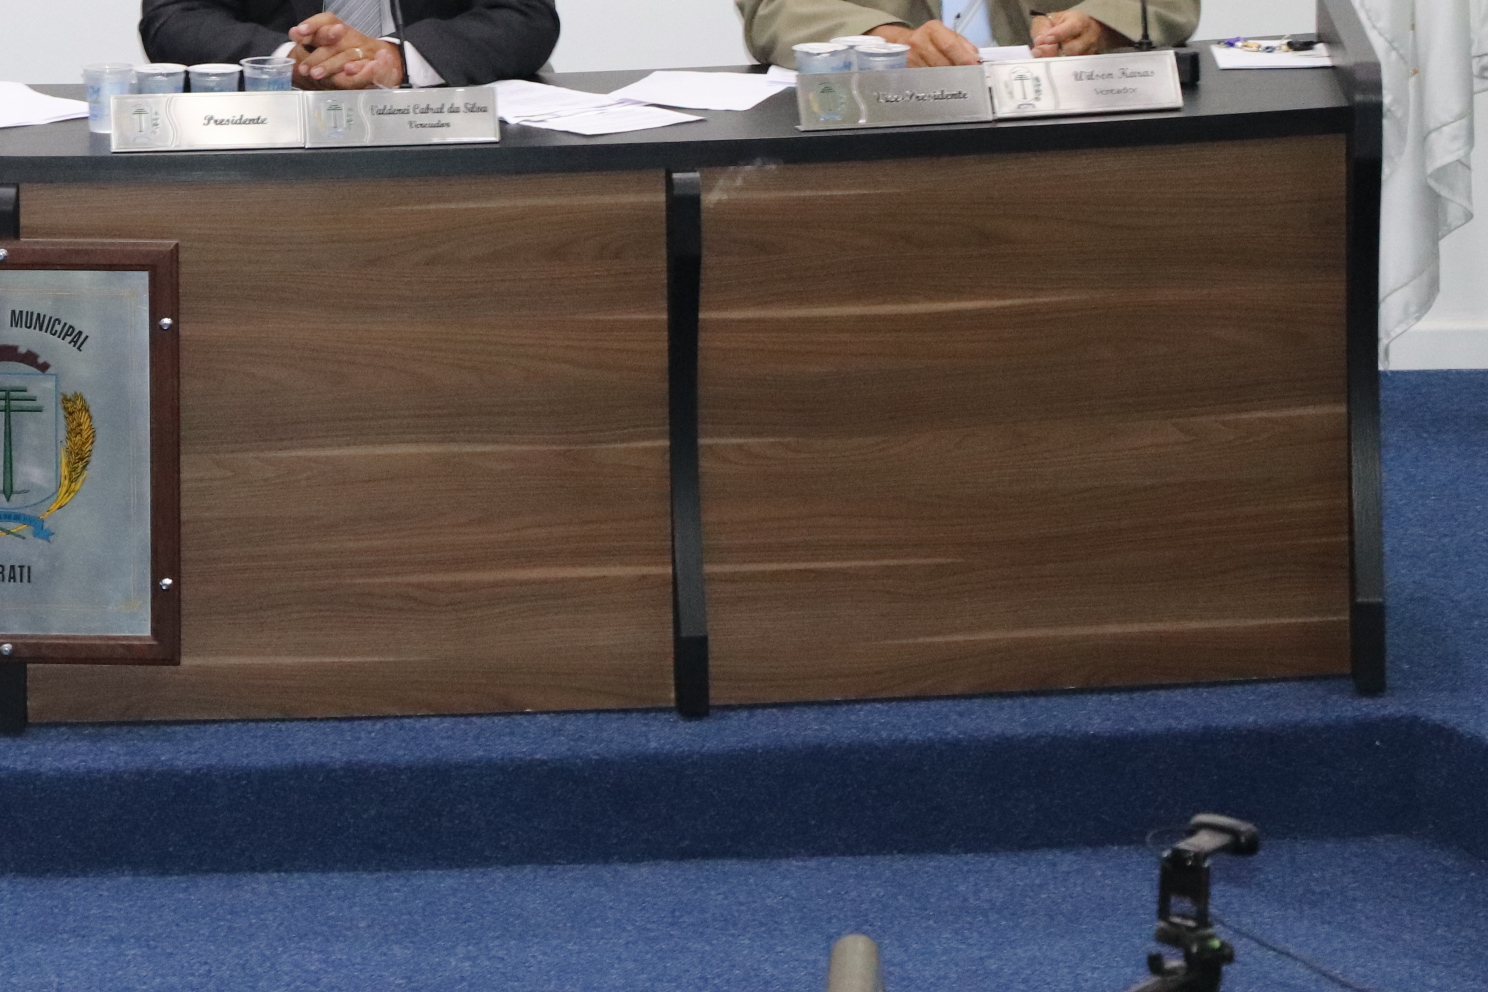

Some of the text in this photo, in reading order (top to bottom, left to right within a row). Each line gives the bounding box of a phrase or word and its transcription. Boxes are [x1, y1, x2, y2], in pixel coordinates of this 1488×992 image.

[412, 103, 445, 115] Cabral
[447, 103, 461, 114] da
[462, 102, 489, 114] Silva
[202, 114, 268, 126] Presidente
[10, 309, 90, 352] MUNICIPAL
